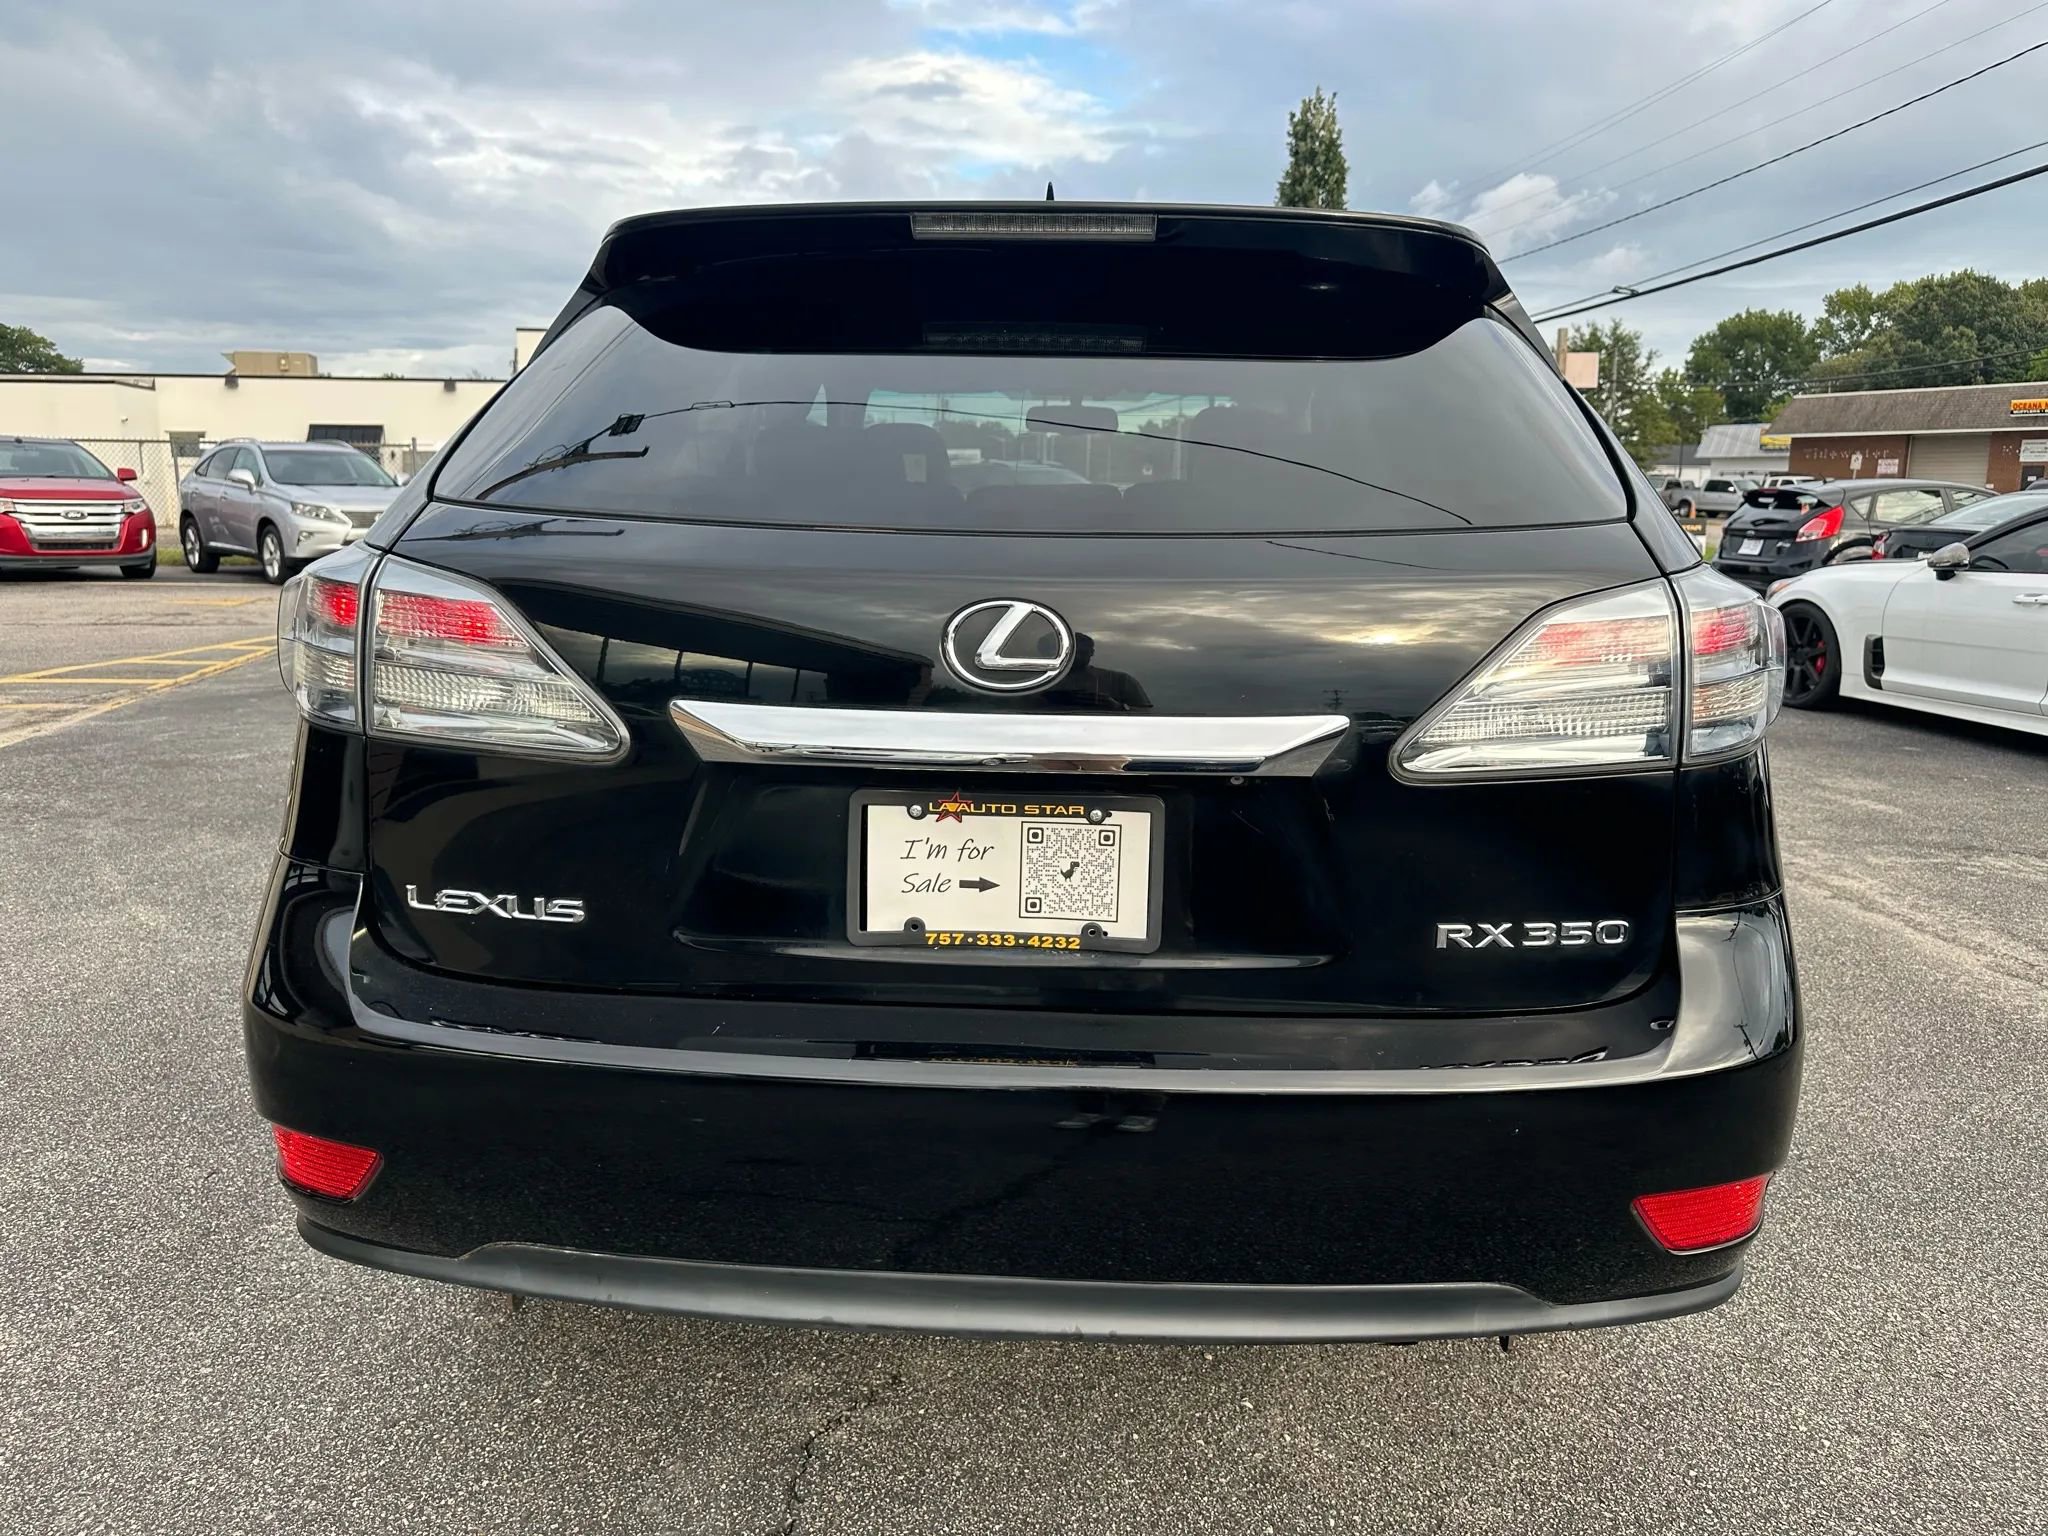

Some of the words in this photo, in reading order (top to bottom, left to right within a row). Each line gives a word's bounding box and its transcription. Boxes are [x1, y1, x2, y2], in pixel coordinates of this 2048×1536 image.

[2012, 401, 2042, 410] OCEANA
[1024, 804, 1085, 815] STAR
[899, 837, 947, 860] I'm
[957, 838, 995, 863] for
[901, 872, 952, 894] Sale
[405, 884, 586, 924] LEXUS
[1435, 922, 1515, 949] RX
[1521, 919, 1630, 947] 350
